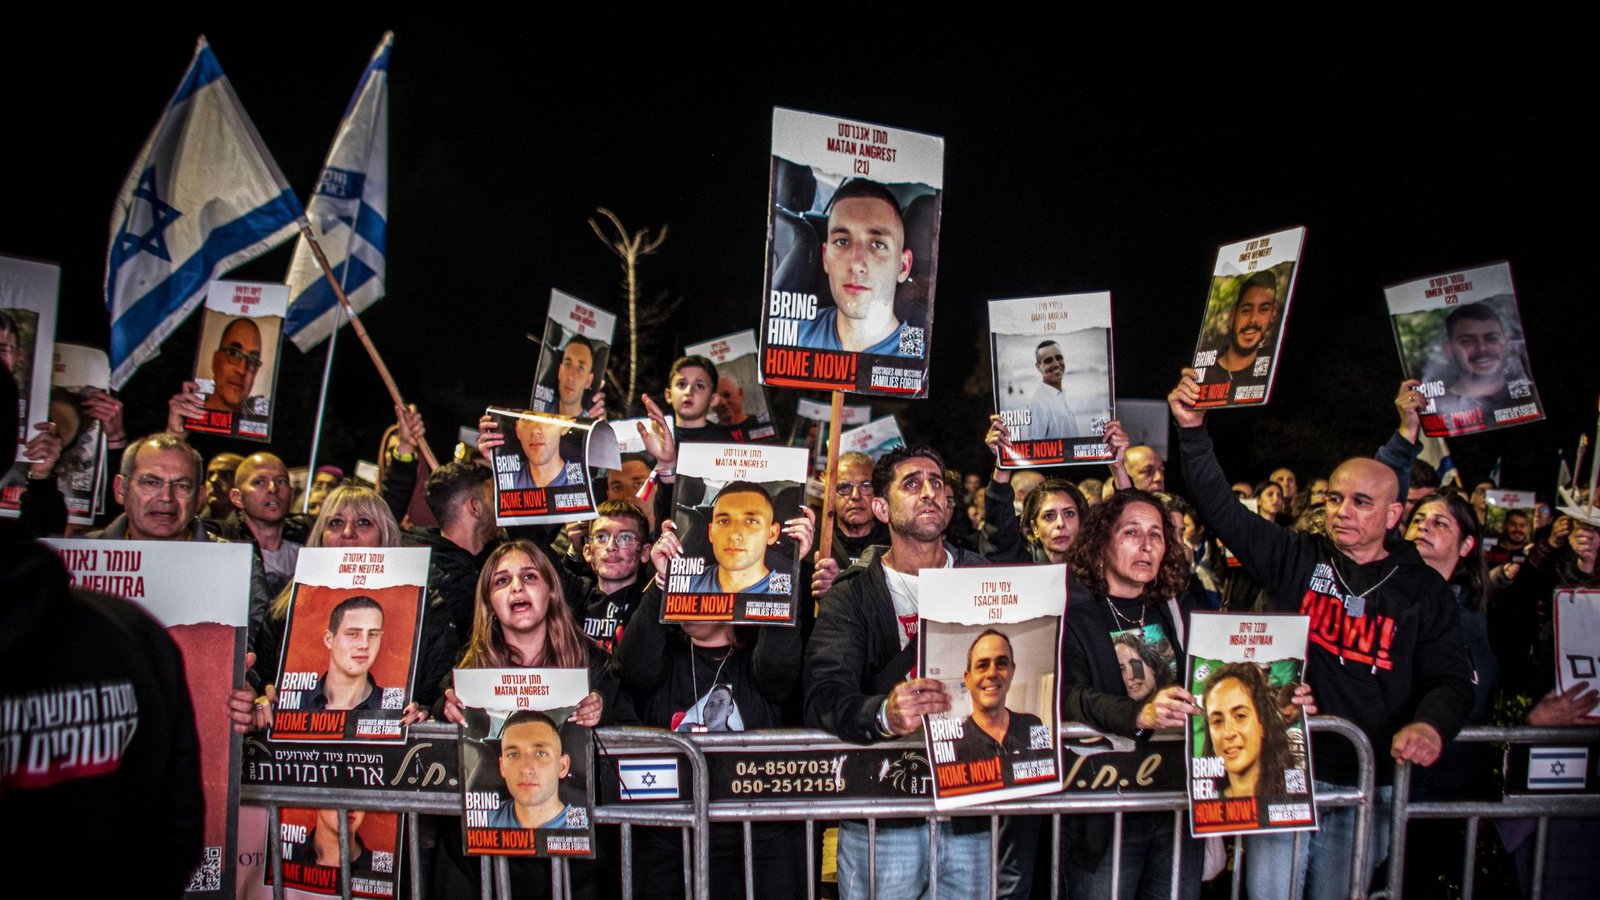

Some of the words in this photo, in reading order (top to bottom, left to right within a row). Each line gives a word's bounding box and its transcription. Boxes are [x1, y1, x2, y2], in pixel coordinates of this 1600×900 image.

[838, 123, 870, 141] אנגרסט
[873, 129, 888, 145] מתן
[827, 137, 857, 155] MATAN
[859, 143, 897, 163] ANGREST
[854, 158, 870, 176] (21)
[1425, 287, 1443, 298] OMER
[769, 290, 818, 321] BRING
[767, 318, 800, 346] HIM
[765, 348, 810, 378] HOME
[813, 352, 858, 381] NOW!
[1195, 349, 1217, 367] BRING
[871, 374, 899, 388] FAMILIES
[900, 377, 922, 390] FORUM
[1208, 382, 1231, 400] NOW!
[535, 384, 554, 403] BRING
[210, 410, 233, 428] NOW!
[1033, 440, 1064, 458] NOW!
[496, 454, 521, 473] BRING
[715, 458, 737, 466] MATAN
[739, 459, 768, 468] ANGREST
[498, 472, 515, 490] HIM
[500, 491, 523, 509] HOME
[523, 489, 547, 508] NOW!
[61, 549, 97, 571] נאוט
[103, 550, 142, 572] עומר
[339, 563, 358, 574] OMER
[358, 564, 384, 574] NEUTRA
[670, 557, 705, 575] BRING
[352, 575, 366, 586] (22)
[1313, 563, 1335, 581] BRIN
[83, 575, 145, 598] NEUTRA
[668, 575, 691, 593] HIM
[981, 582, 997, 594] עידן
[999, 581, 1011, 592] צחי
[666, 595, 698, 613] HOME
[701, 593, 734, 614] NOW!
[974, 595, 1000, 607] TSACHI
[1001, 594, 1018, 605] IDAN
[746, 606, 770, 616] FAMILIES
[771, 608, 790, 617] FORUM
[988, 607, 1003, 620] (51)
[1300, 589, 1394, 659] NOW!
[1229, 635, 1247, 645] INBAR
[1248, 635, 1273, 645] HAYMAN
[281, 672, 318, 690] BRING
[501, 674, 527, 684] אנגרסט
[529, 674, 542, 685] מתן
[495, 686, 518, 696] MATAN
[519, 686, 549, 696] ANGREST
[278, 691, 301, 710] HIM
[516, 697, 530, 708] (21)
[275, 712, 308, 731] HOME
[310, 710, 346, 732] NOW!
[357, 725, 382, 735] FAMILIES
[382, 725, 402, 735] FORUM
[930, 718, 964, 741] BRING
[275, 750, 319, 761] לאירועים
[323, 751, 343, 763] ציוד
[347, 753, 384, 764] השכרת
[933, 739, 956, 763] HIM
[258, 762, 338, 784] יזמויות
[350, 765, 385, 786] ארי
[937, 766, 968, 787] HOME
[969, 757, 1002, 783] NOW!
[1192, 757, 1225, 778] BRING
[465, 791, 500, 810] BRING
[467, 810, 489, 828] HIM
[1195, 801, 1223, 824] HOME
[1226, 797, 1257, 821] NOW!
[281, 823, 307, 844] RING
[467, 829, 499, 848] HOME
[501, 829, 535, 849] NOW!
[547, 842, 570, 850] FAMILIES
[571, 842, 590, 850] FORUM
[303, 866, 337, 888] NOW!
[351, 883, 373, 893] AMILIES
